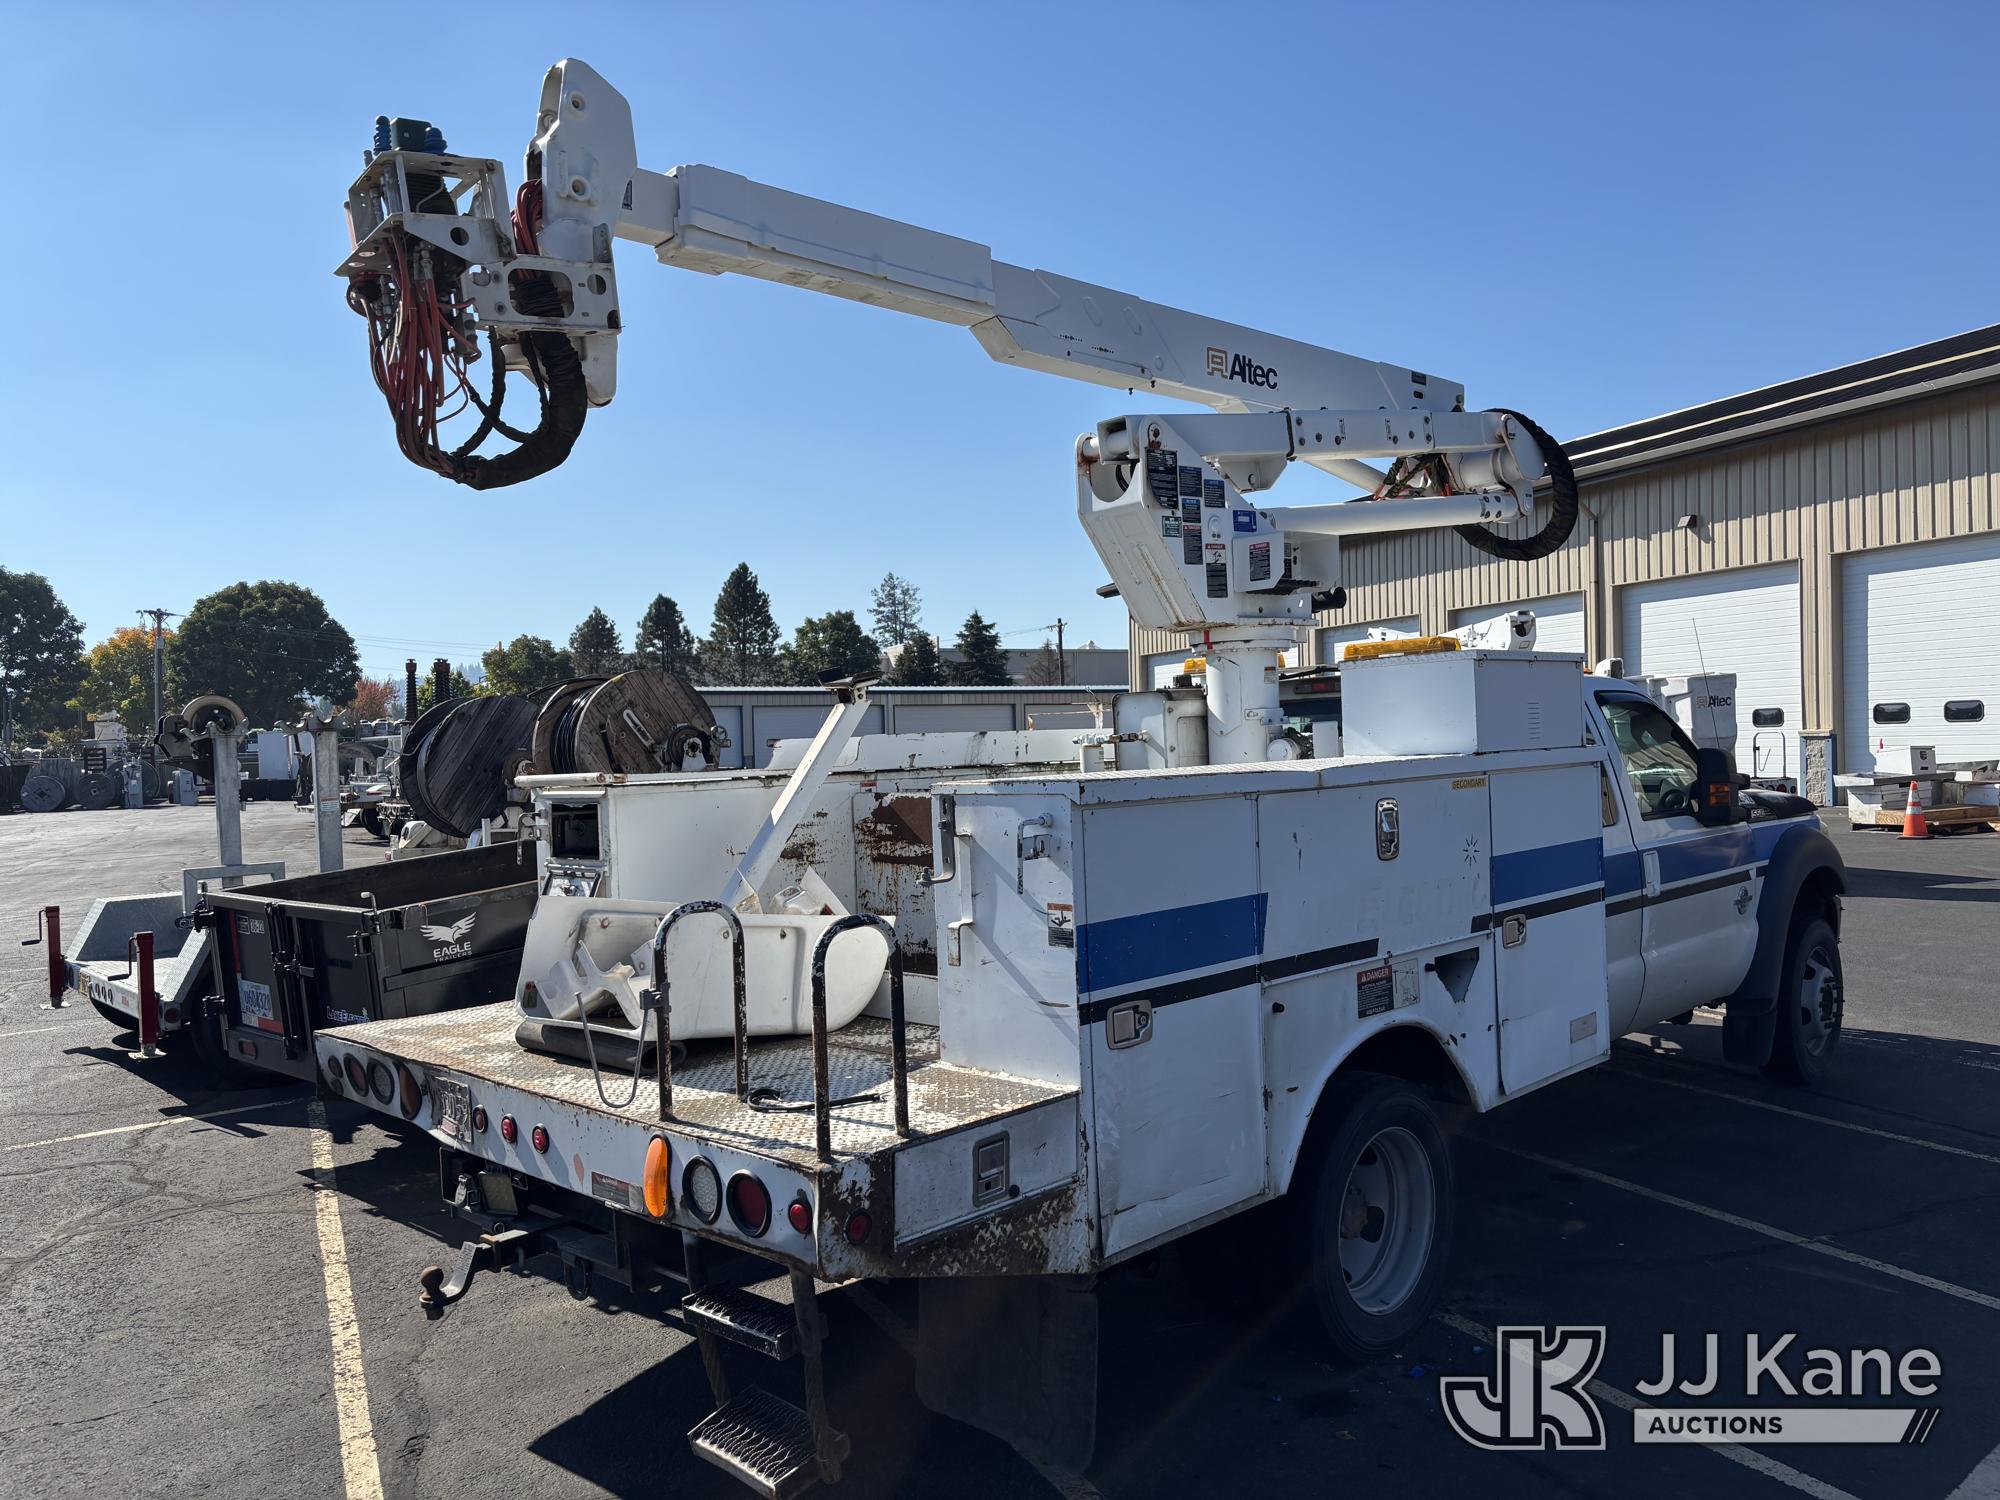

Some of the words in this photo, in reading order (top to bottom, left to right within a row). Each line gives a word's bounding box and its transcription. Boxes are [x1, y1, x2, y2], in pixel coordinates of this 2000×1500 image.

[1229, 353, 1278, 390] Altec
[1708, 696, 1732, 707] Altec
[433, 941, 471, 958] EAGLE
[435, 951, 472, 963] TRAILERS
[1367, 968, 1389, 981] DANGER
